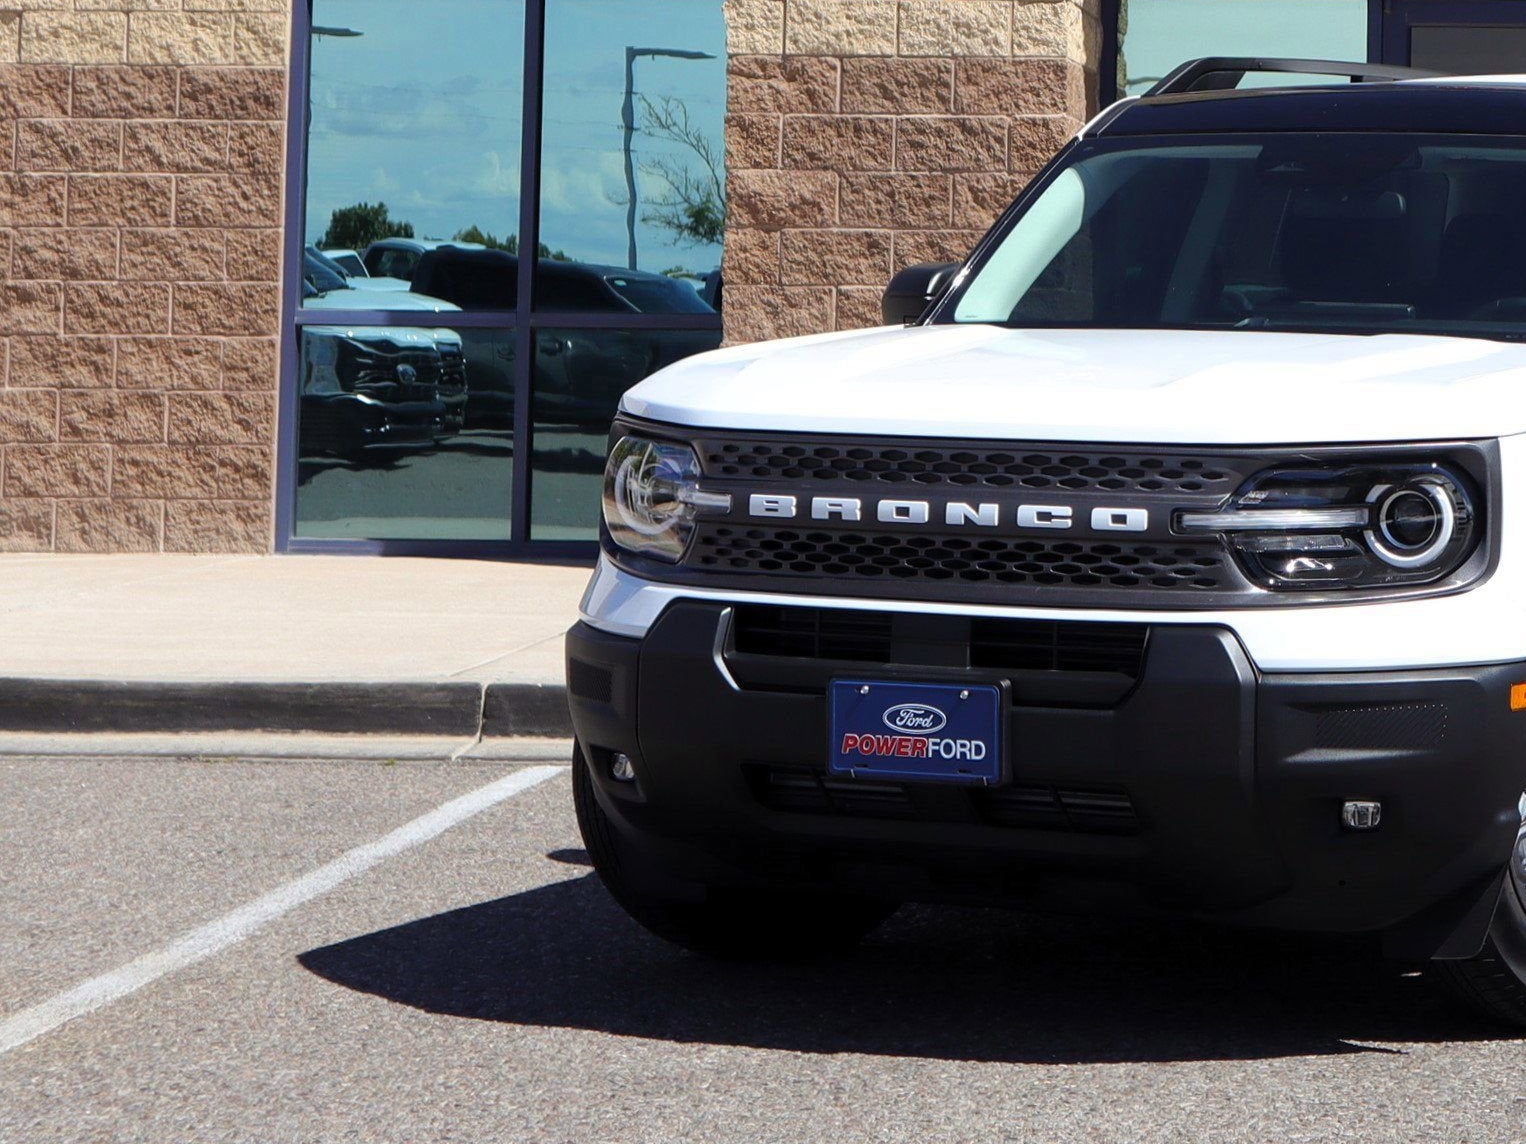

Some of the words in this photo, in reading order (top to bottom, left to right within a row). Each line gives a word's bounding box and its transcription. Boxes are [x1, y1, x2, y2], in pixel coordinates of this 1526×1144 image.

[748, 494, 1149, 532] BRONCO
[896, 708, 934, 728] Ford
[841, 733, 986, 761] POWERFORD
